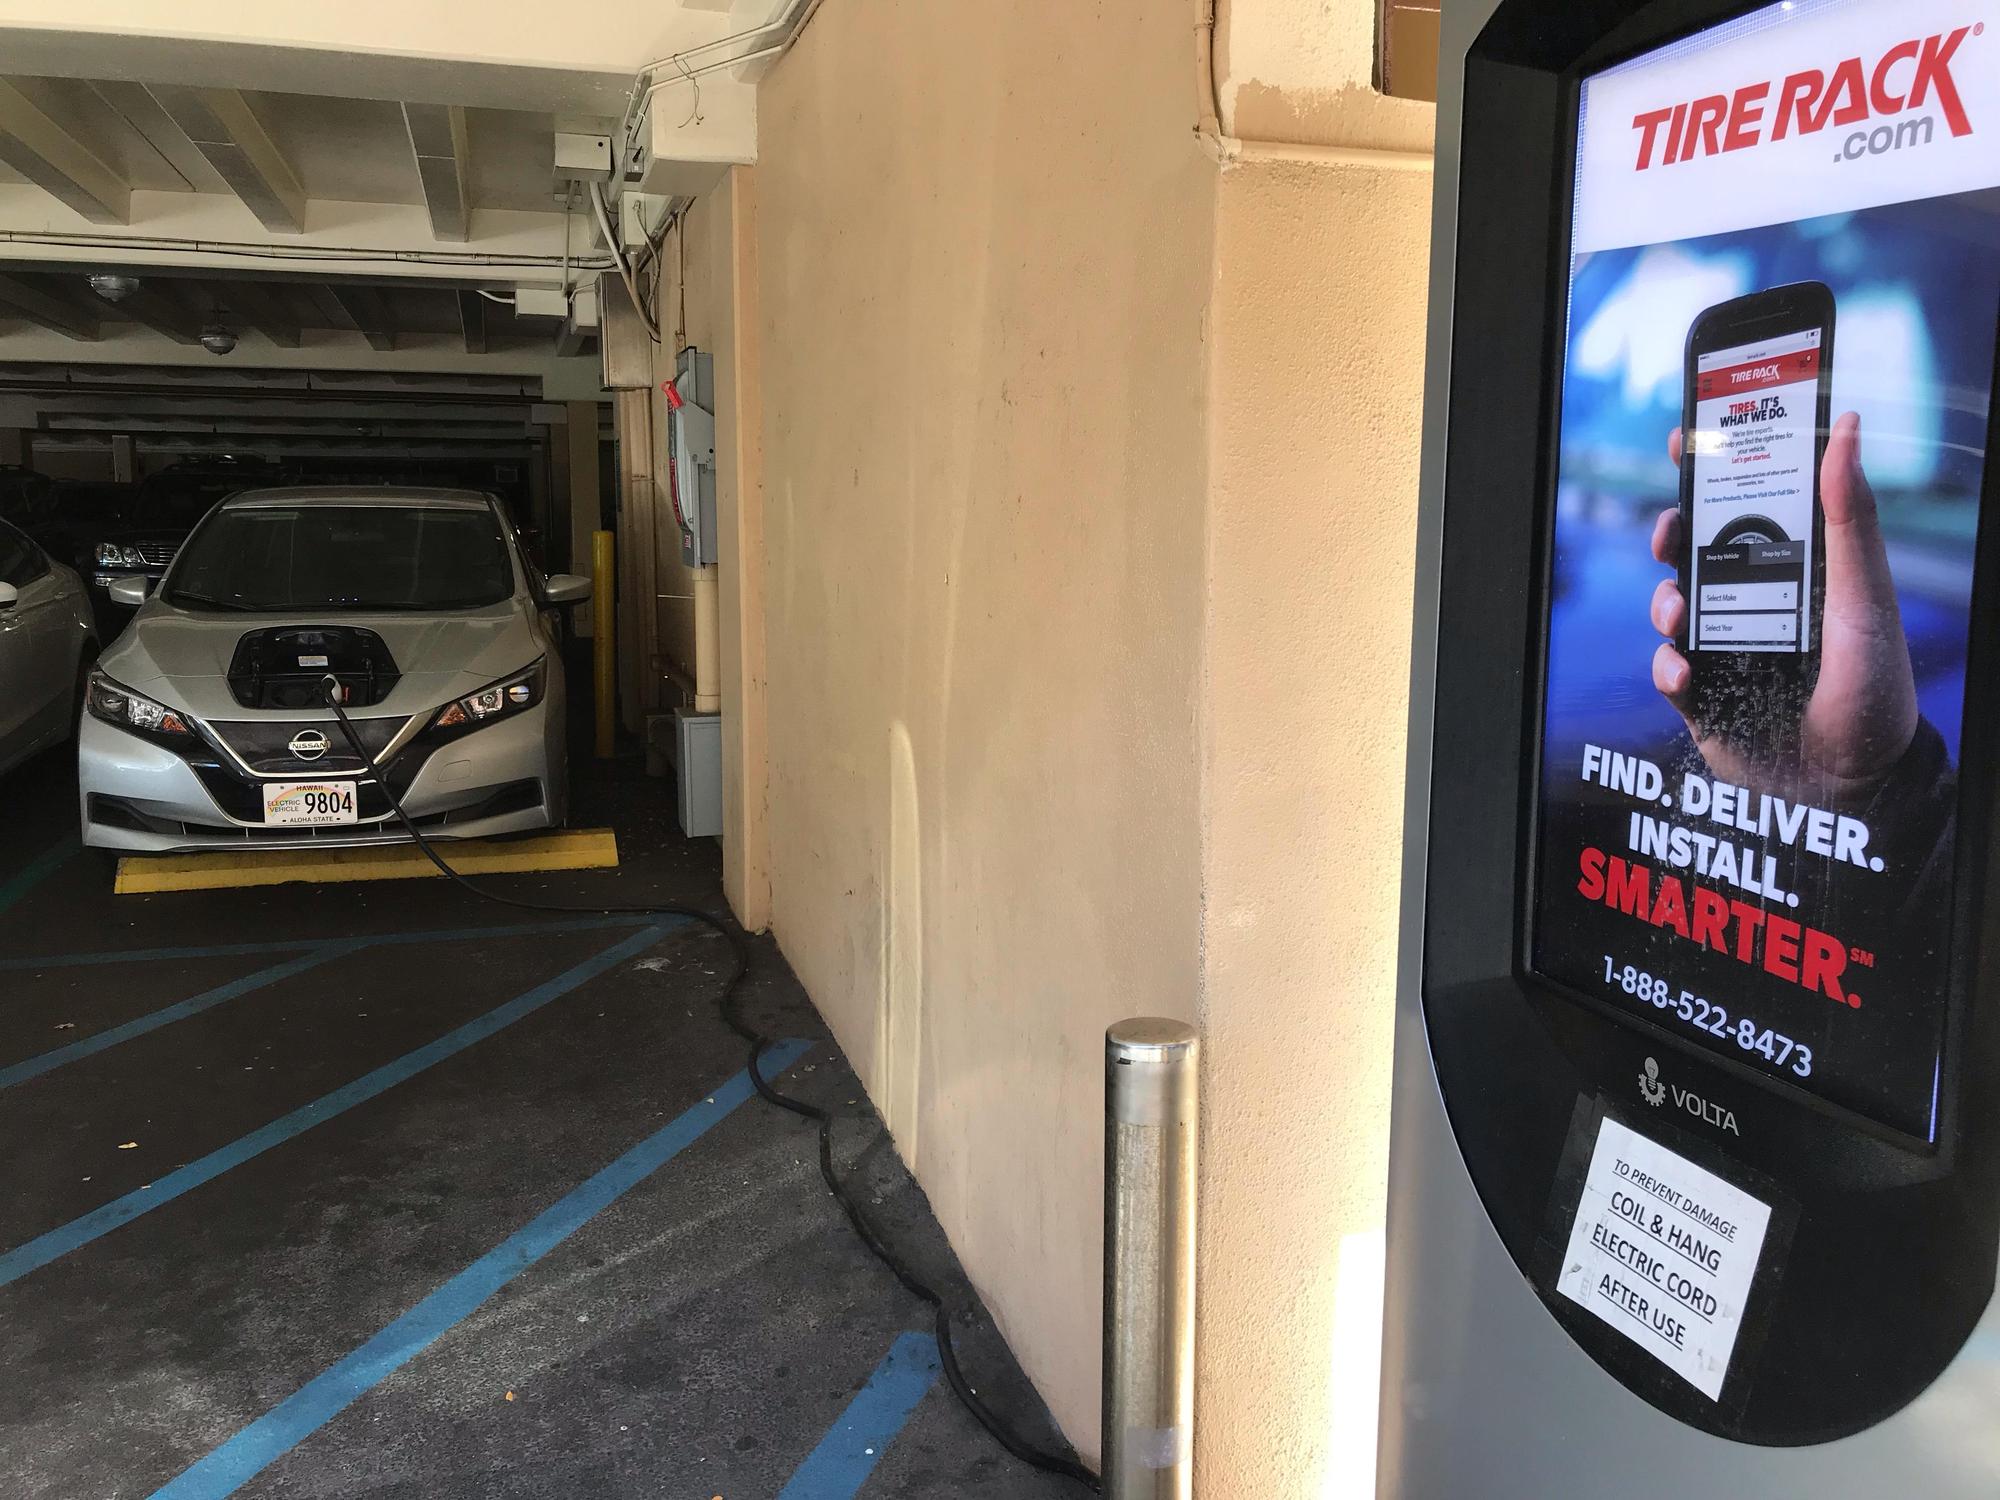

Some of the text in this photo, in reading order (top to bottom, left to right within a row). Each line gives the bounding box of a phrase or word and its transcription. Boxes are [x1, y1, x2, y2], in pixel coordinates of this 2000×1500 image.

[1632, 25, 1973, 171] TIRE RACK
[1833, 116, 1933, 163] .com
[1731, 364, 1780, 384] TIRE RACK
[1720, 407, 1787, 428] WHAT WE DO.
[1728, 396, 1779, 415] TIRES. IT'S
[1763, 435, 1774, 443] right
[1706, 594, 1737, 602] Select Make
[1705, 624, 1733, 632] Select Year
[292, 742, 327, 750] NISSAN
[267, 799, 301, 807] ELECTRIC
[304, 791, 353, 814] 9804
[1581, 743, 1885, 873] FIND. DELIVER.
[1628, 812, 1800, 908] INSTALL.
[1577, 847, 1862, 1009] SMARTER.
[1604, 955, 1813, 1078] 1-888-522-8473
[1671, 1084, 1740, 1137] VOLTA
[1615, 1159, 1738, 1240] TO PREVENT DAMAGE
[1611, 1191, 1722, 1271] COIL & HANG
[1592, 1223, 1718, 1317] ELECTRIC CORD
[1599, 1273, 1687, 1347] AFTER USE
